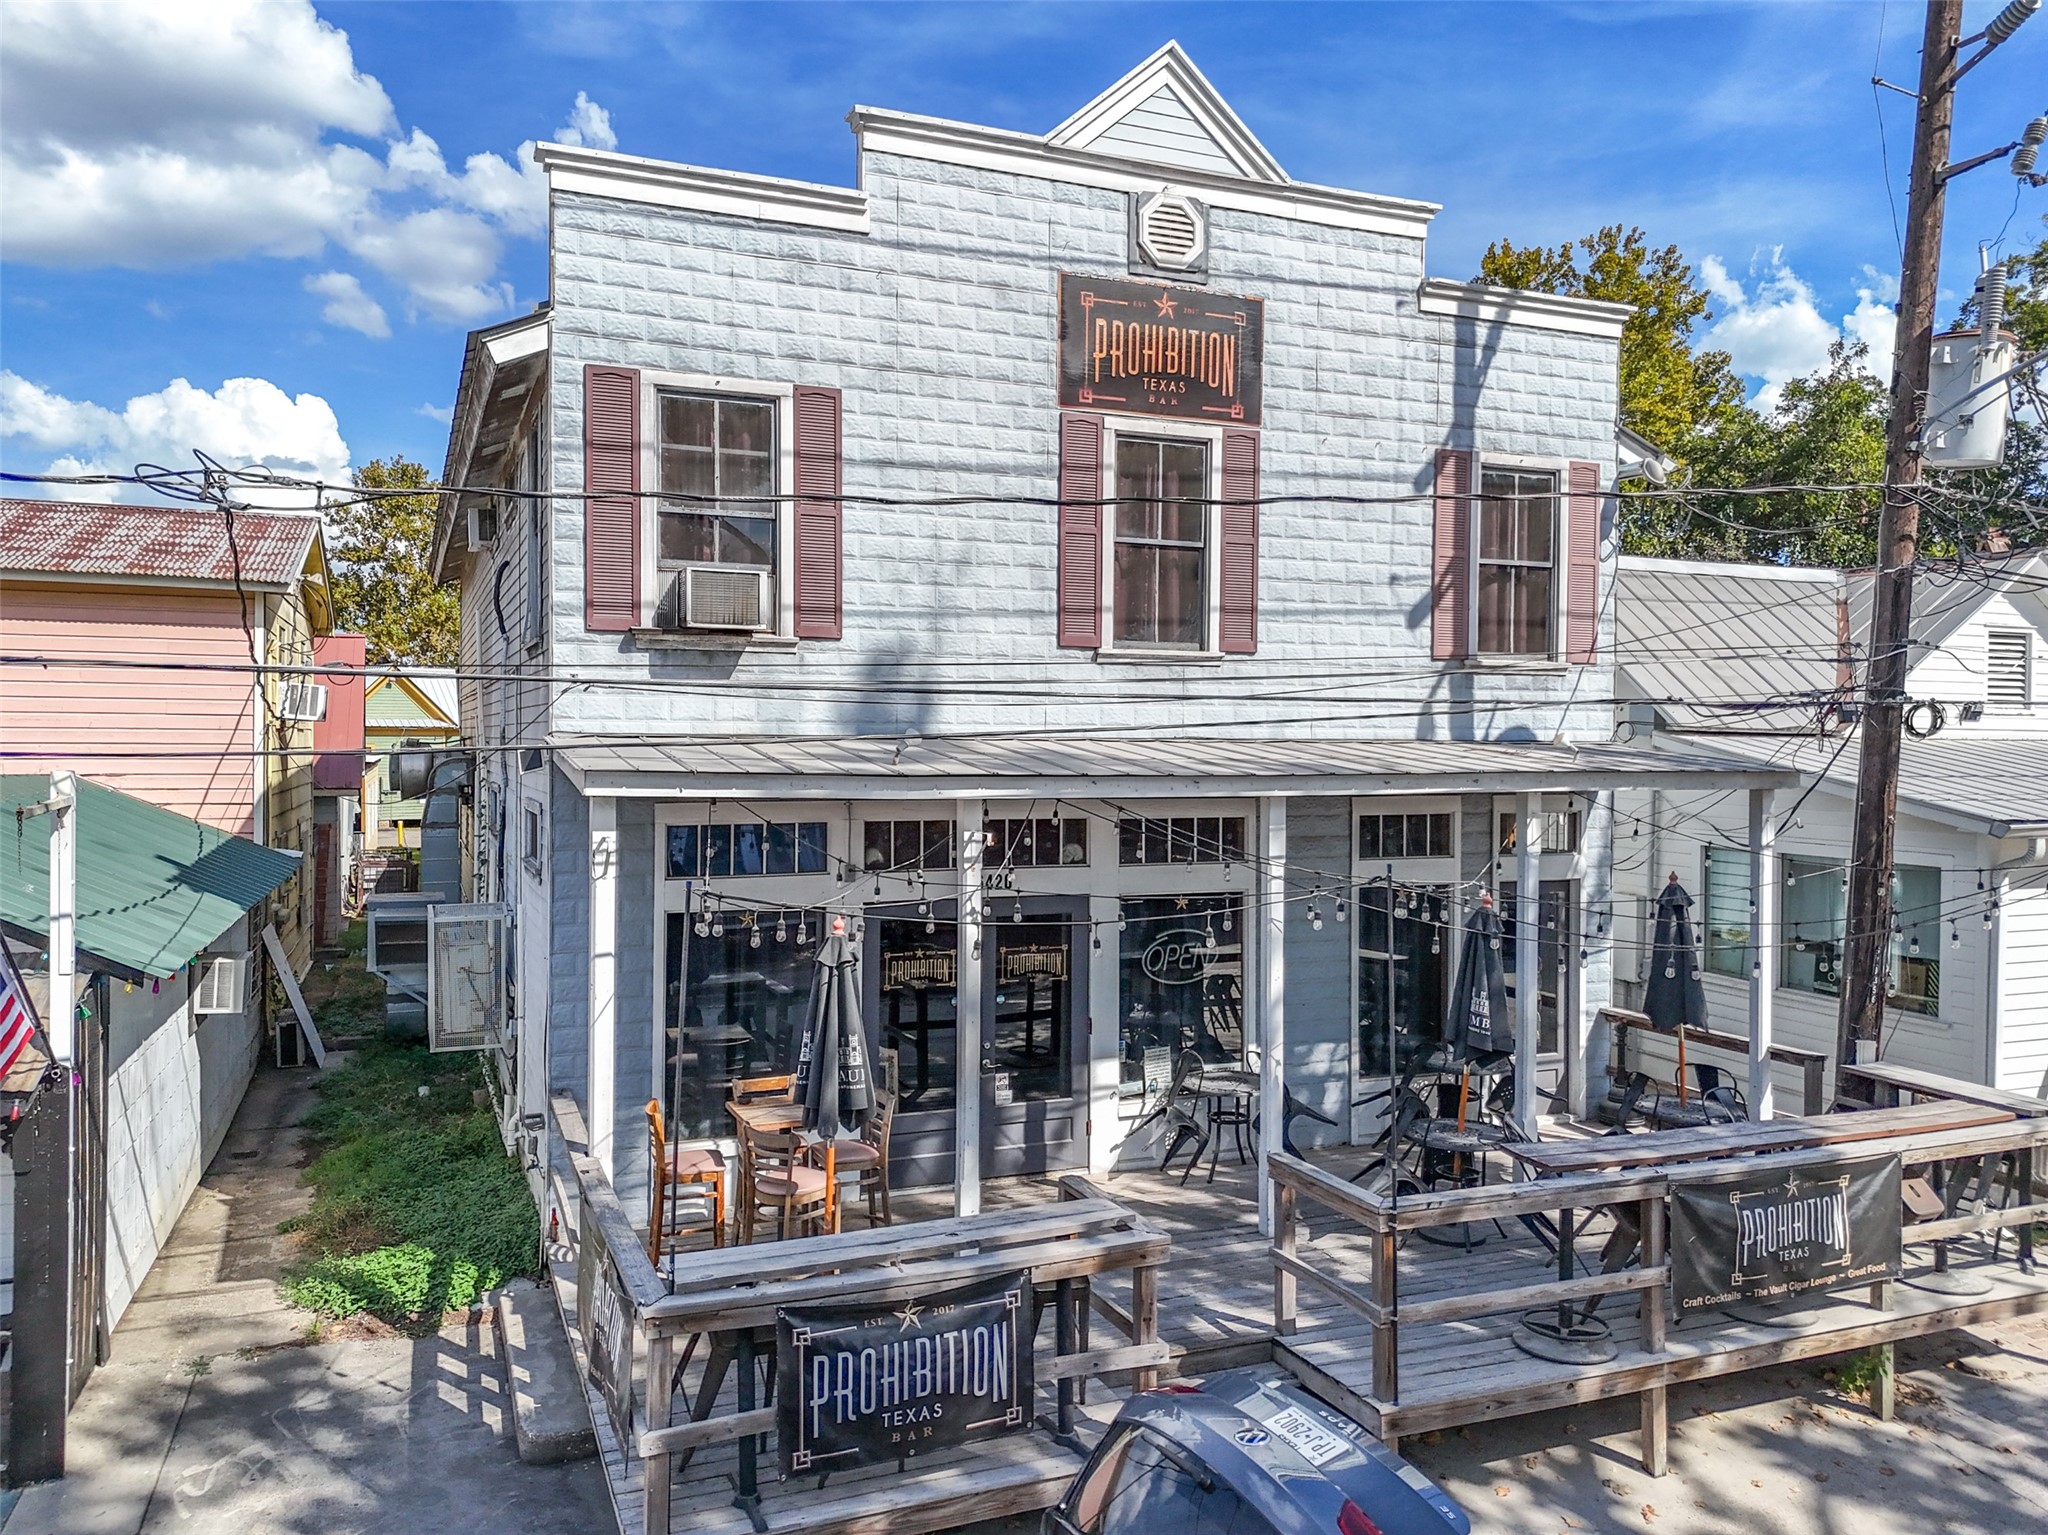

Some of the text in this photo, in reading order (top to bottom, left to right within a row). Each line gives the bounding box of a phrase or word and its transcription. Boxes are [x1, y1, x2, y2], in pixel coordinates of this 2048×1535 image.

[1093, 317, 1235, 397] PROHIBITION
[1142, 376, 1187, 394] TEXAS
[1148, 394, 1179, 406] BAR
[1007, 952, 1062, 979] PROHIBITION
[1146, 942, 1212, 972] OPEN
[890, 958, 949, 985] PROHIBITION
[1742, 1193, 1845, 1267] PROHIBITION
[1778, 1246, 1810, 1262] TEXAS
[1682, 1262, 1887, 1308] Craft Cocktails The Vault Cigar Lounge Great Food
[863, 1304, 956, 1329] EST. 2017
[809, 1320, 1008, 1439] PROHIBITION
[881, 1402, 943, 1428] TEXAS
[891, 1425, 934, 1443] BAR
[1439, 1505, 1457, 1520] SE
